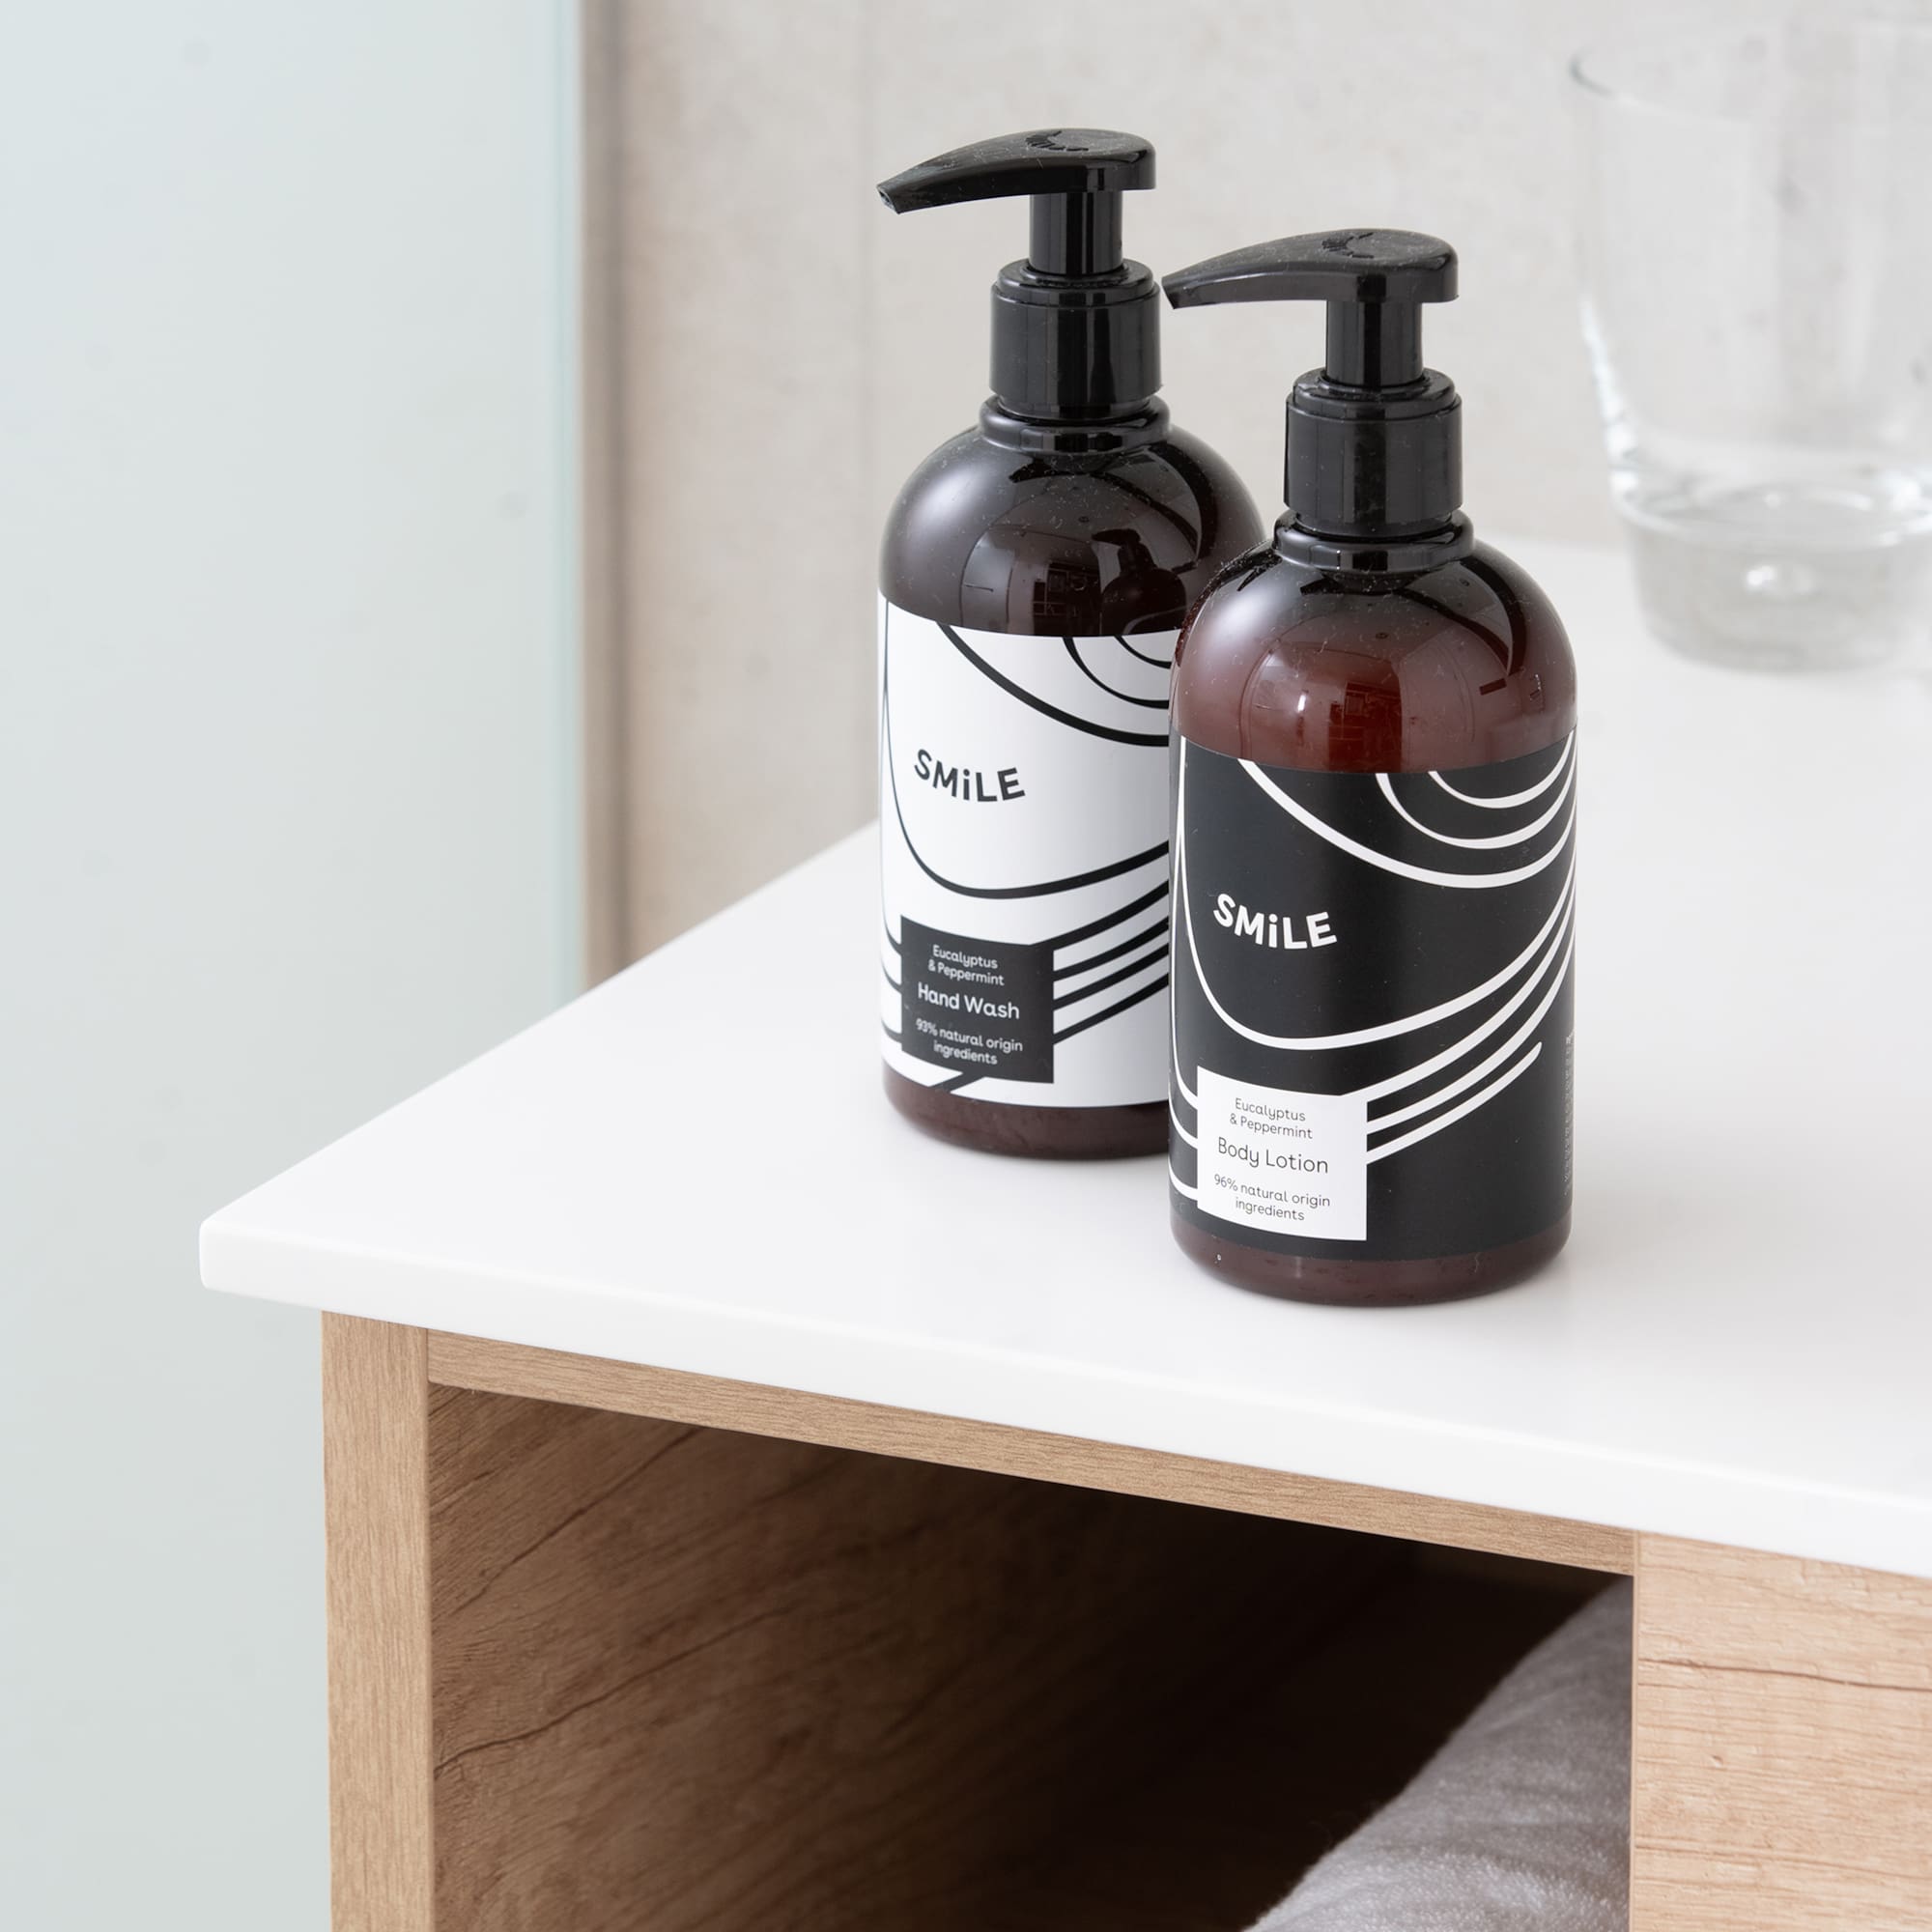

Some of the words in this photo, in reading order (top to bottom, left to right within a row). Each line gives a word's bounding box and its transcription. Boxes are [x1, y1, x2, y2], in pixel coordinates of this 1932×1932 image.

[932, 944, 999, 969] Eucalyptus
[927, 959, 936, 972] &
[937, 961, 1005, 986] Peppermint
[918, 981, 960, 1010] Hand
[964, 995, 1020, 1020] Wash
[933, 1039, 998, 1065] ingredients
[939, 1028, 983, 1047] natural
[985, 1037, 1024, 1054] origin
[1235, 1097, 1306, 1122] Eucalyptus
[1229, 1113, 1238, 1125] &
[1240, 1116, 1313, 1140] Peppermint
[1218, 1136, 1260, 1168] Body
[1265, 1149, 1328, 1174] Lotion
[1214, 1173, 1238, 1192] 96%
[1240, 1182, 1289, 1203] natural
[1292, 1193, 1331, 1209] origin
[1236, 1197, 1305, 1221] ingredients
